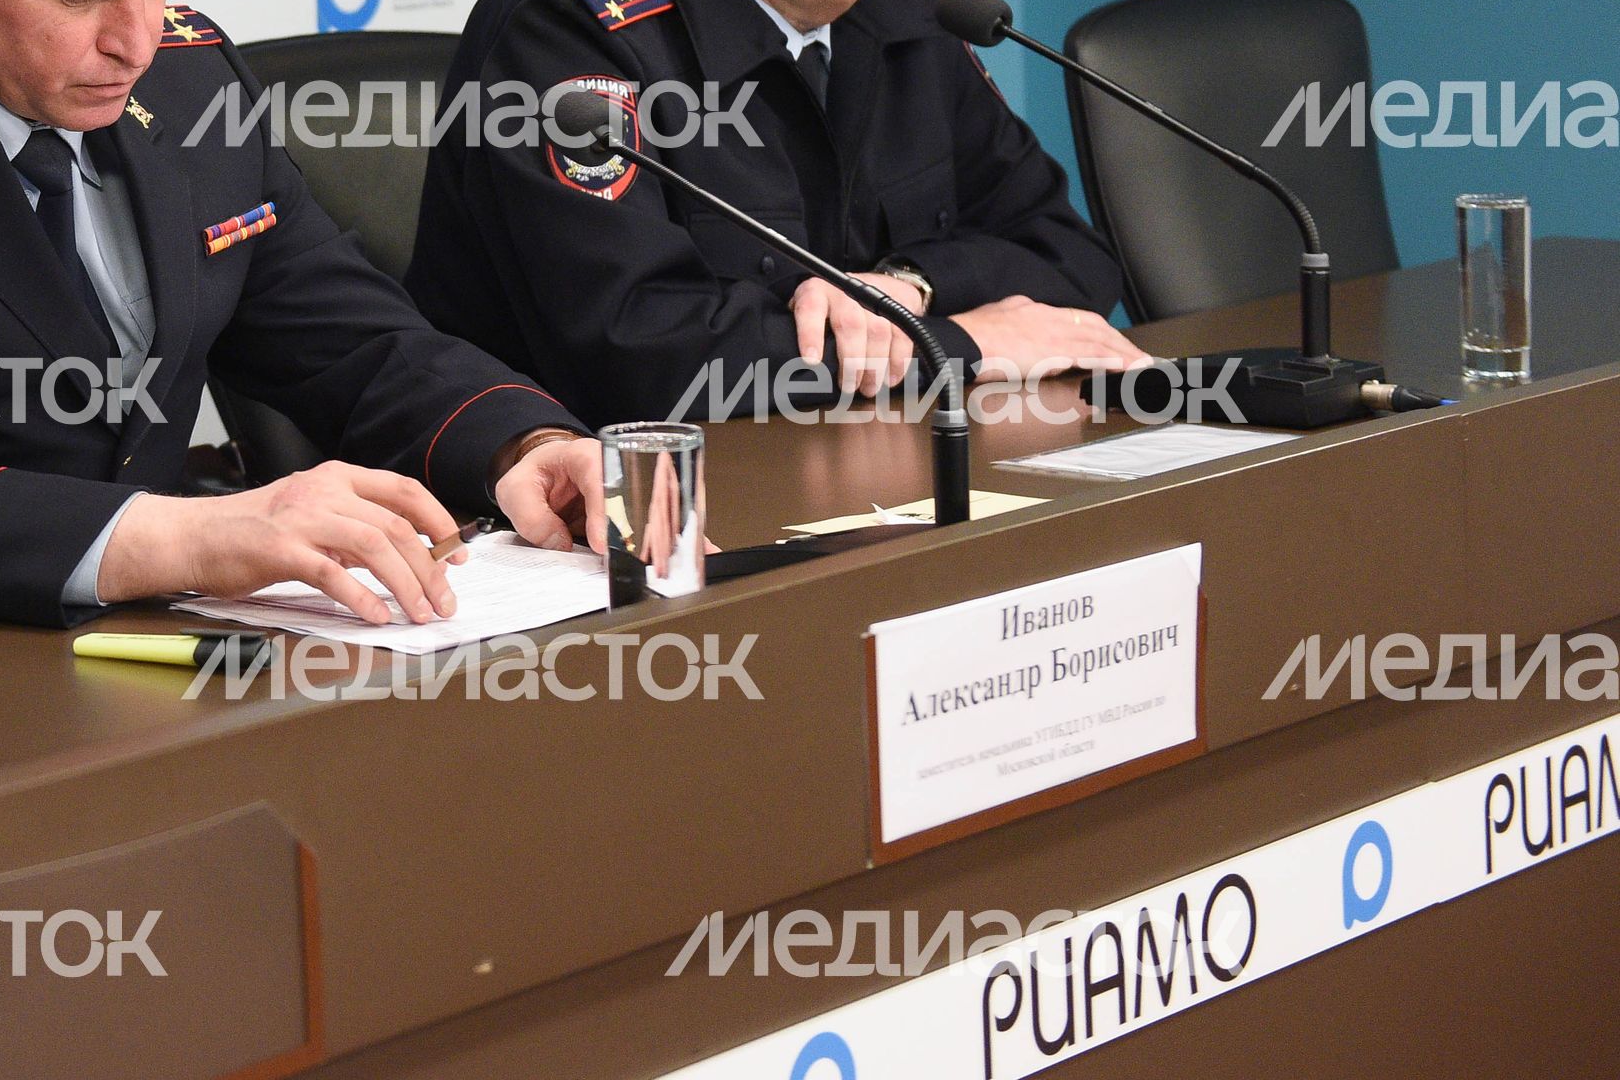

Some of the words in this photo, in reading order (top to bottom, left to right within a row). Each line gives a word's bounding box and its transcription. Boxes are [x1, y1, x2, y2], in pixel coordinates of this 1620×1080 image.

[1000, 594, 1094, 641] Иванов
[900, 662, 1041, 726] Александр
[1051, 623, 1179, 683] Борисович
[982, 873, 1257, 1080] РИАМО
